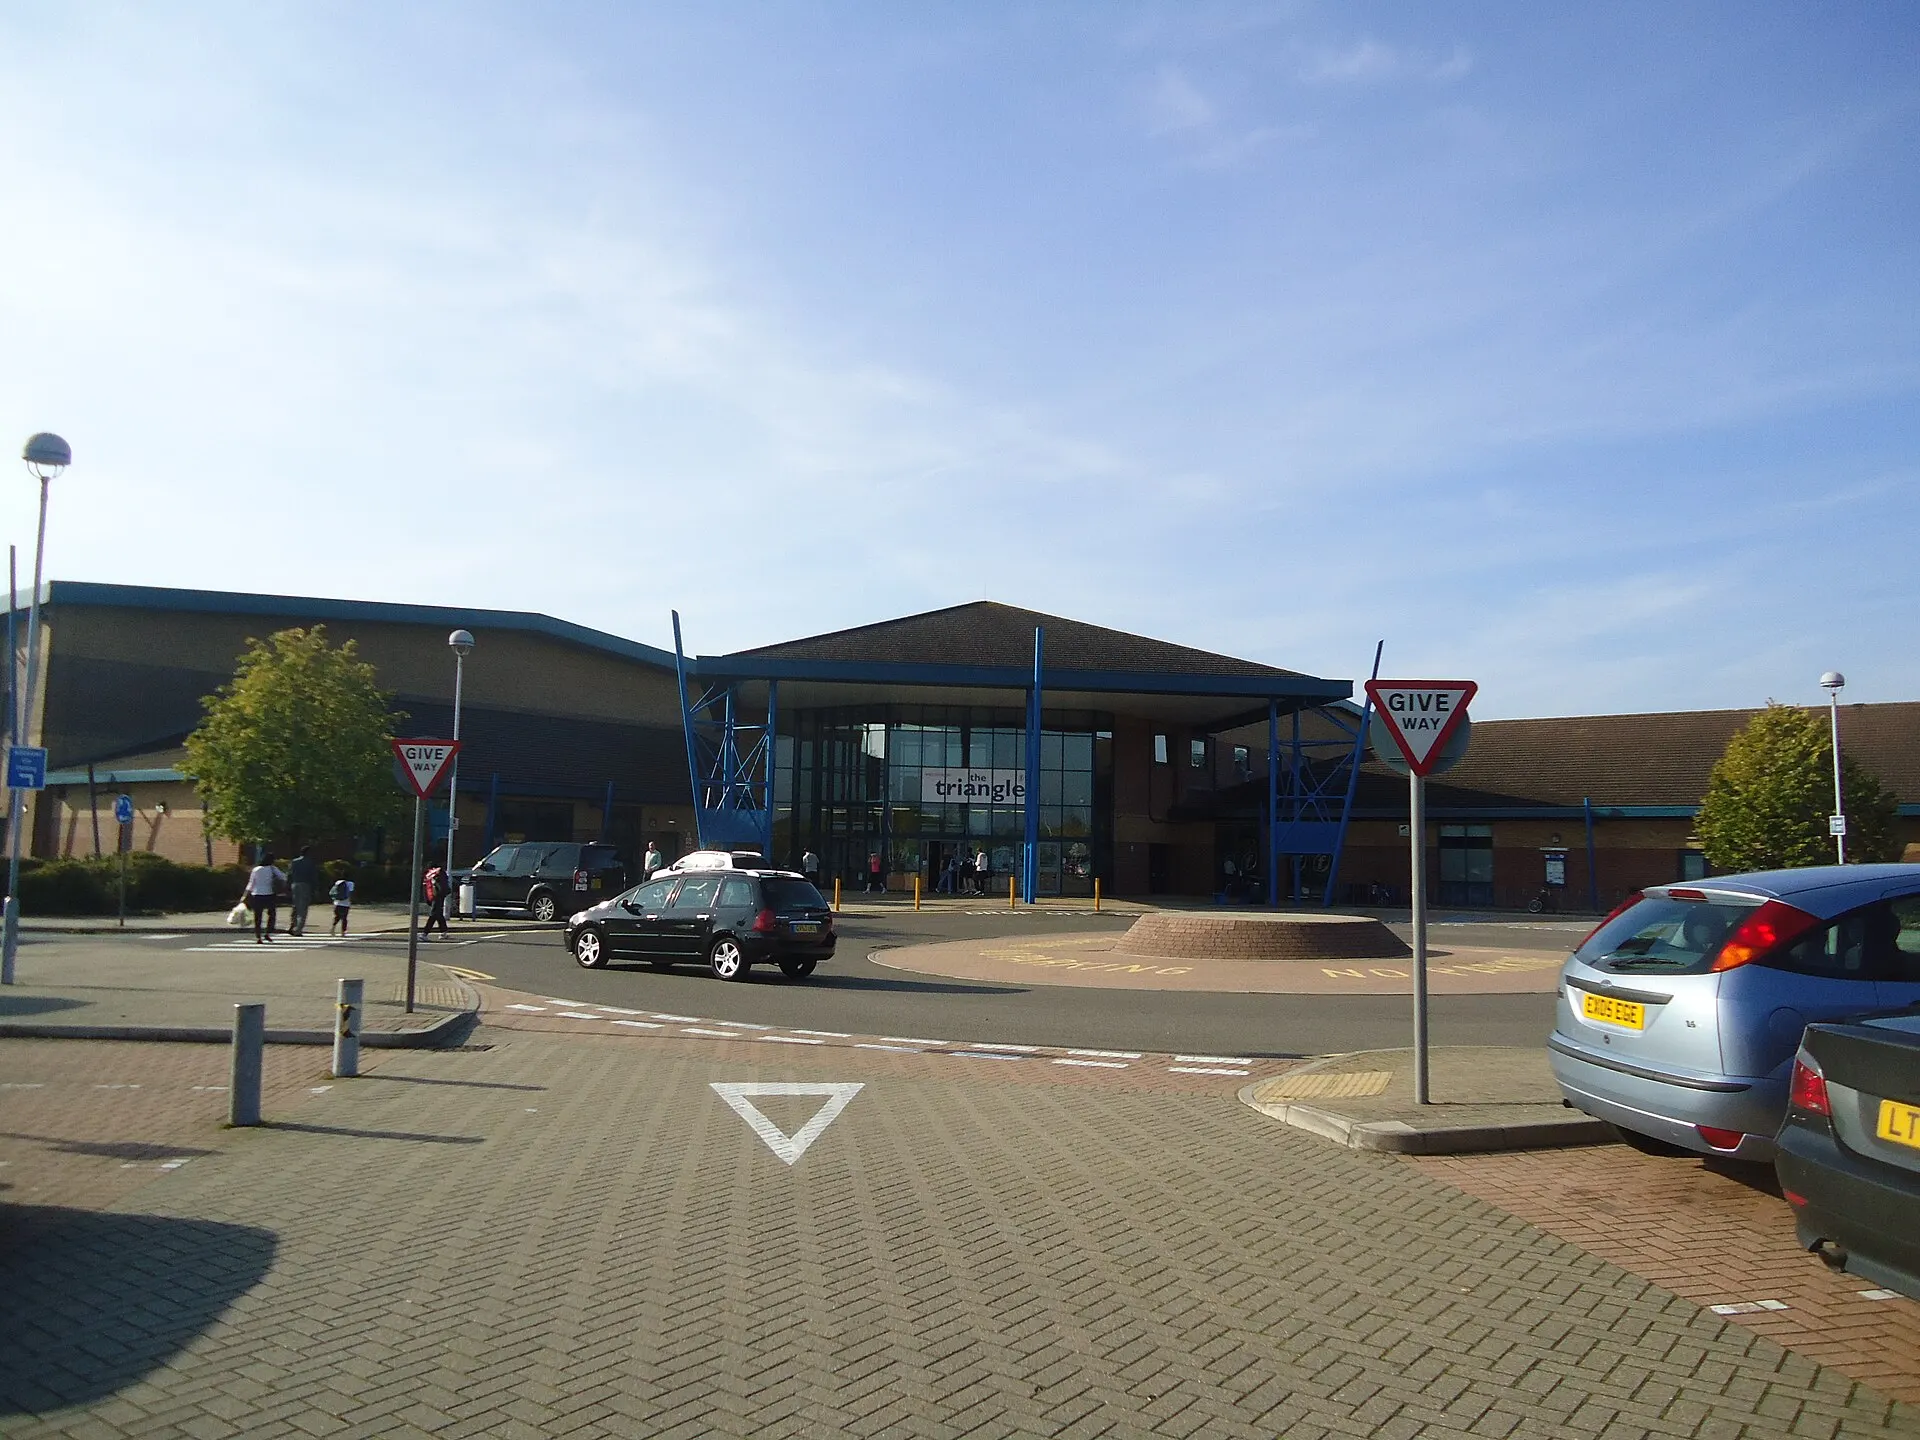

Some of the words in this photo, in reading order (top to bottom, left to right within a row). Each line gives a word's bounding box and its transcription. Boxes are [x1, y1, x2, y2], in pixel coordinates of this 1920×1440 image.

[1388, 693, 1449, 712] GIVE
[1402, 717, 1440, 730] WAY
[406, 747, 444, 760] GIVE
[413, 763, 438, 771] WAY
[970, 773, 987, 782] the
[935, 778, 1025, 802] triangle
[1321, 967, 1410, 979] NO
[1888, 1107, 1920, 1140] LT
